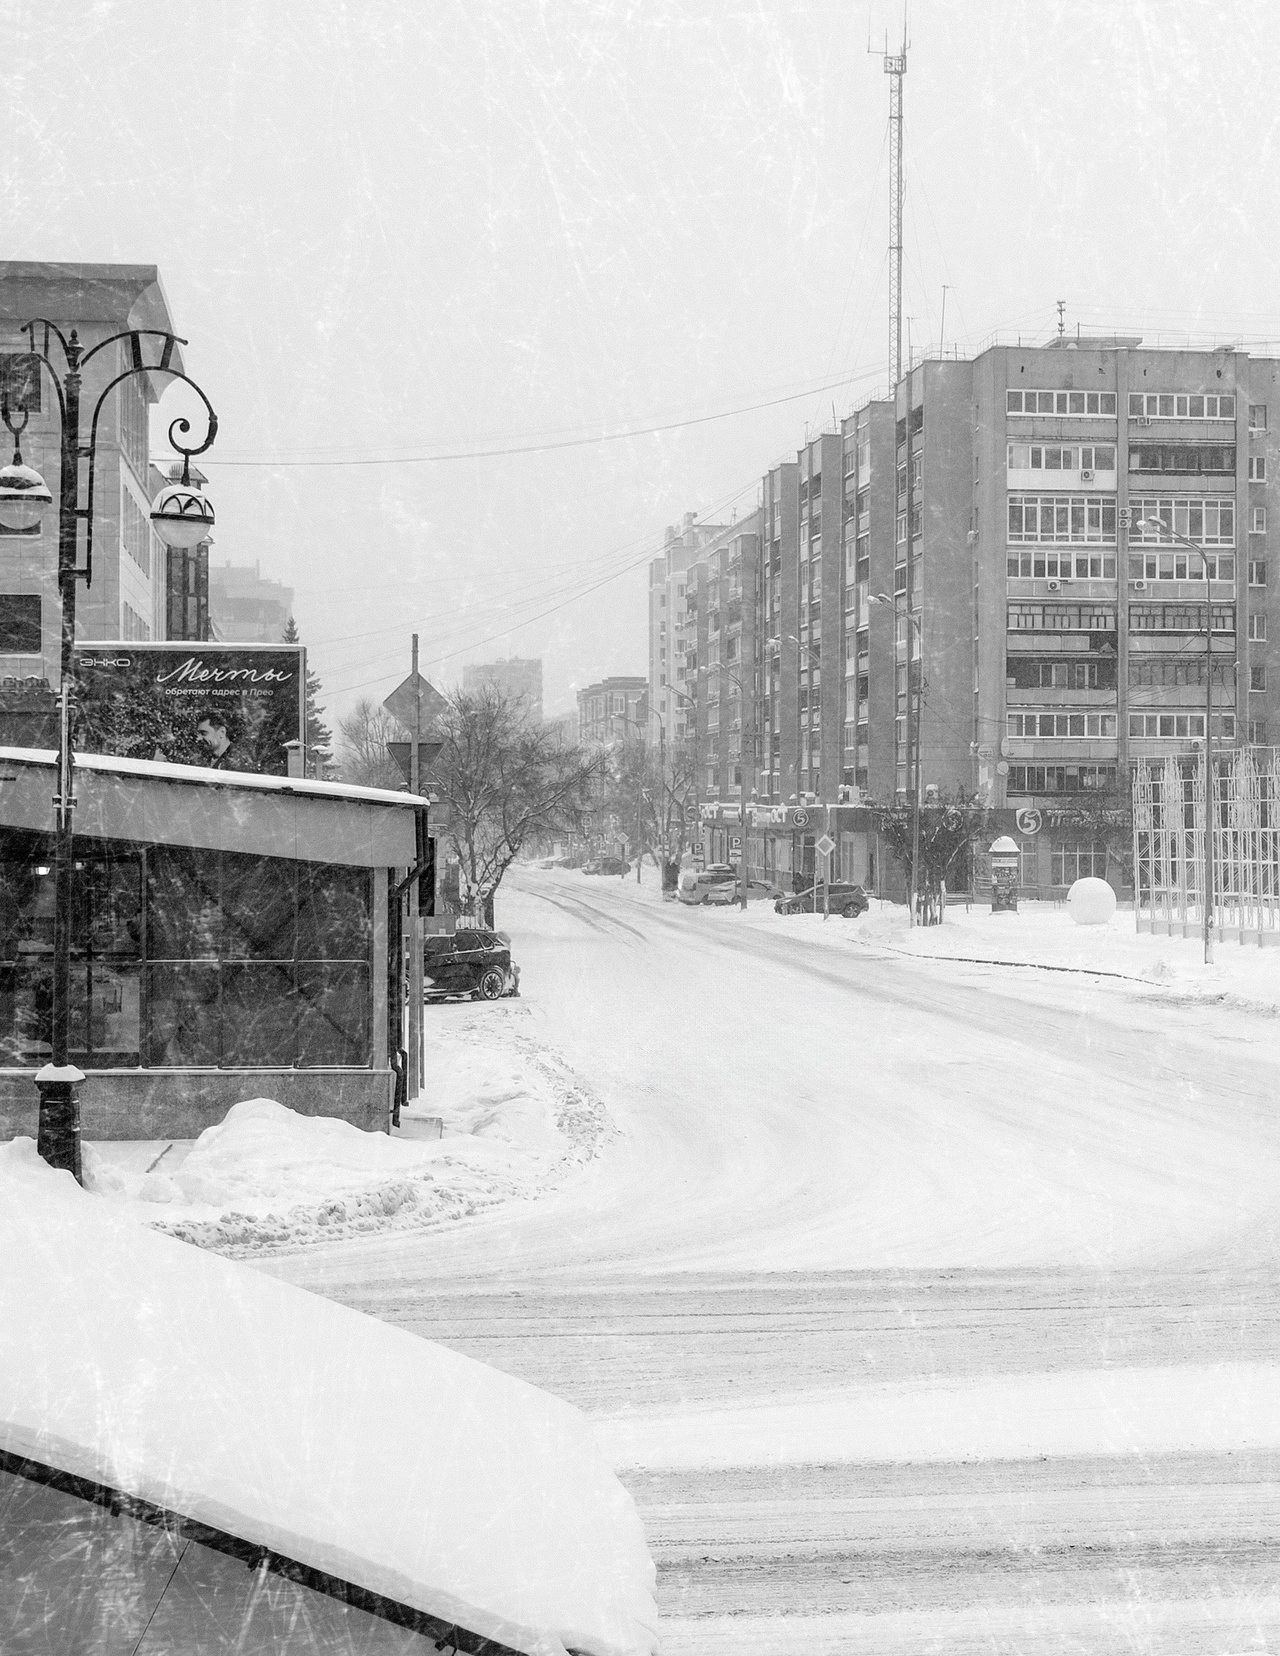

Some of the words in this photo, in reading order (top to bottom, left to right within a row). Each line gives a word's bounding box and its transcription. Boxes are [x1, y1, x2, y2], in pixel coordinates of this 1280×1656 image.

[156, 657, 293, 684] Мечты
[165, 687, 210, 697] обретают
[212, 689, 240, 698] адрес
[250, 689, 274, 697] Прео
